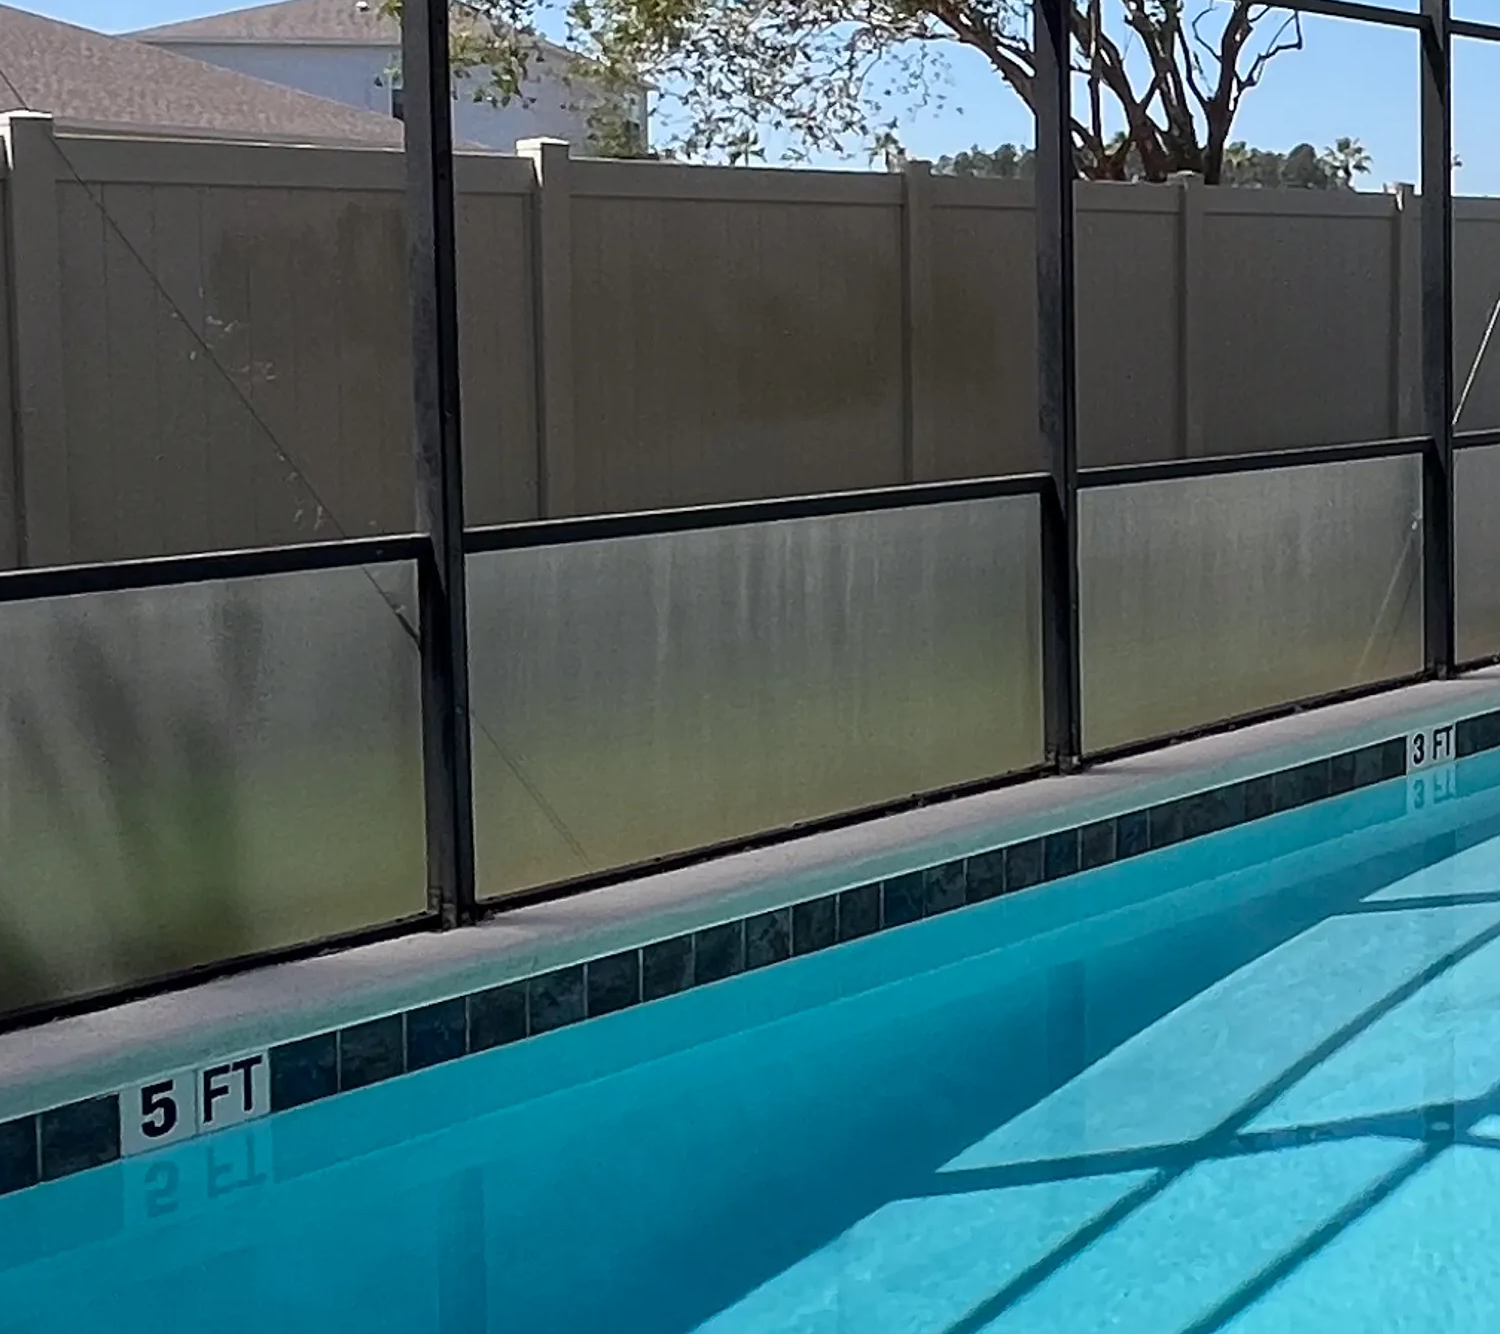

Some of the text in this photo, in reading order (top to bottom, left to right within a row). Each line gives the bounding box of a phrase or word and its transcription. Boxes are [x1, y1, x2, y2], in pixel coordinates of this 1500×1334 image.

[1413, 725, 1453, 765] 3 FT
[141, 1054, 263, 1138] 5 FT
